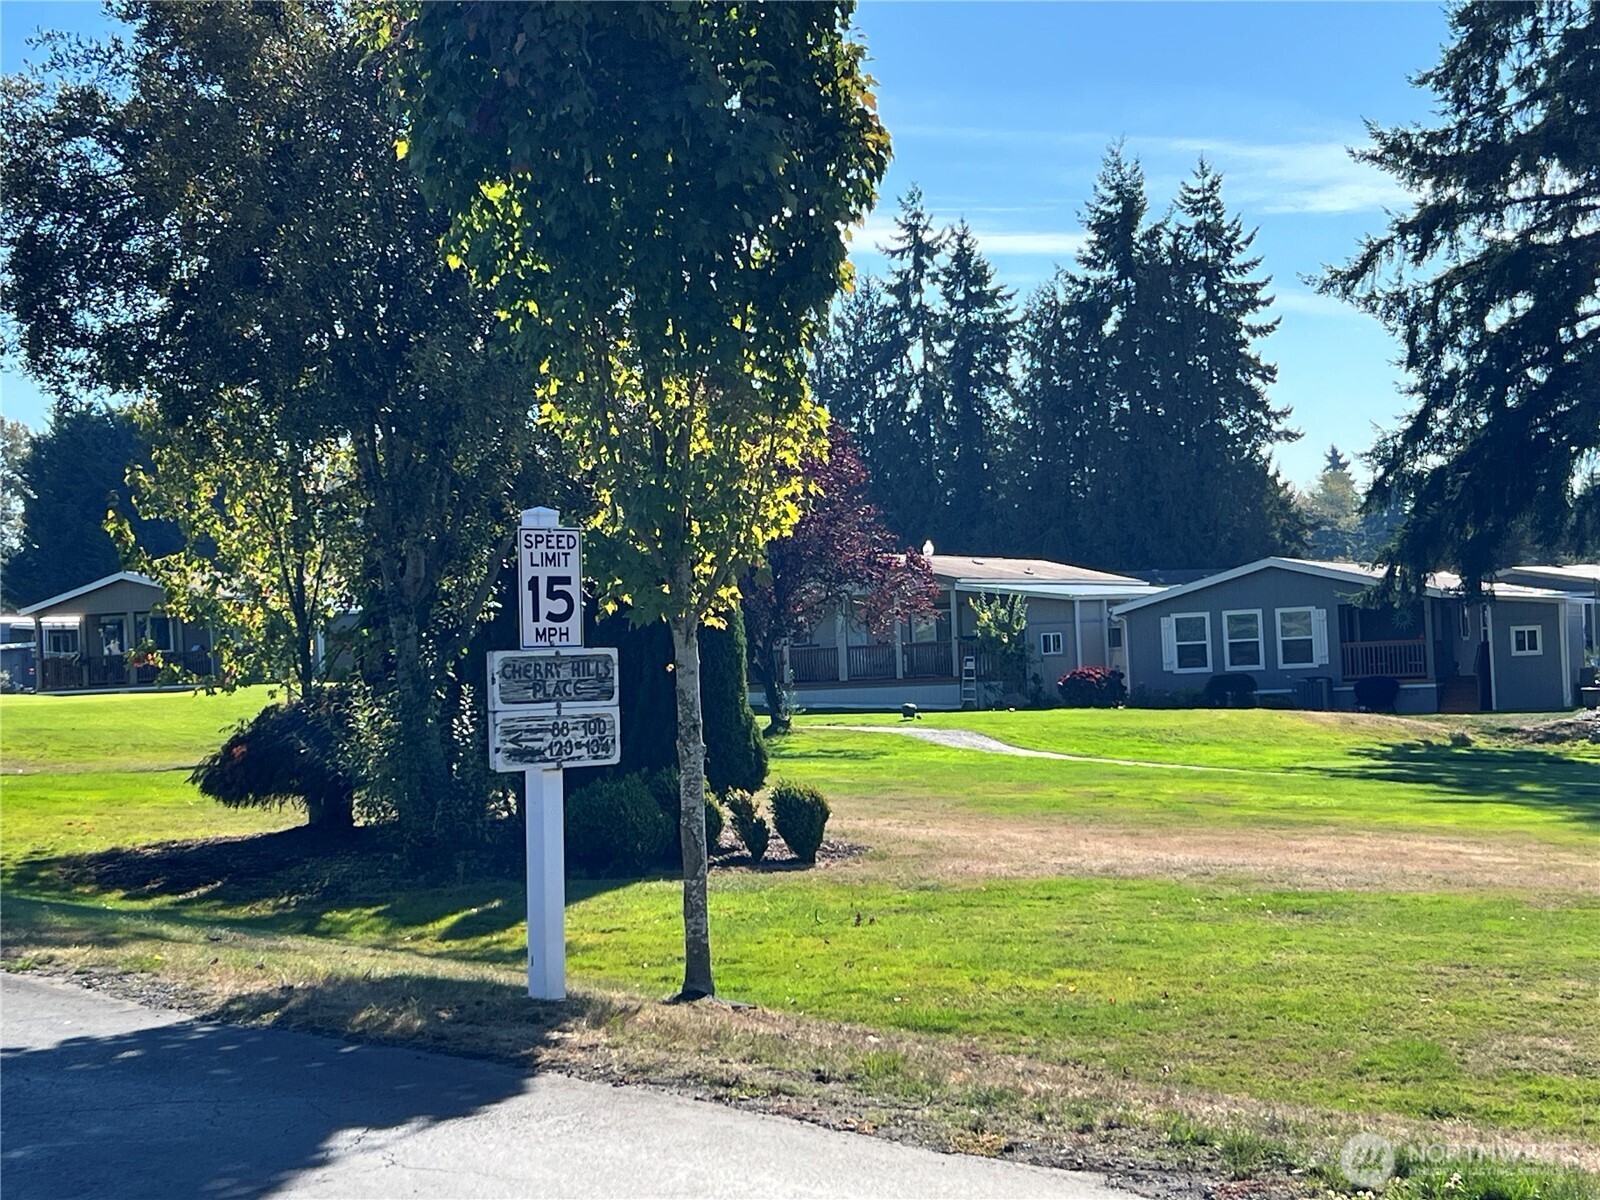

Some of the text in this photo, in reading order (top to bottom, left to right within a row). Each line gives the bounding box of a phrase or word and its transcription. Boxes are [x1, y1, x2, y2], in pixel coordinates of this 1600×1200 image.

[524, 533, 577, 549] SPEED
[530, 552, 571, 568] LIMIT
[527, 575, 575, 623] 15
[535, 627, 570, 643] MPH
[501, 660, 611, 679] CHERRY HILLS
[532, 680, 581, 698] PLACE
